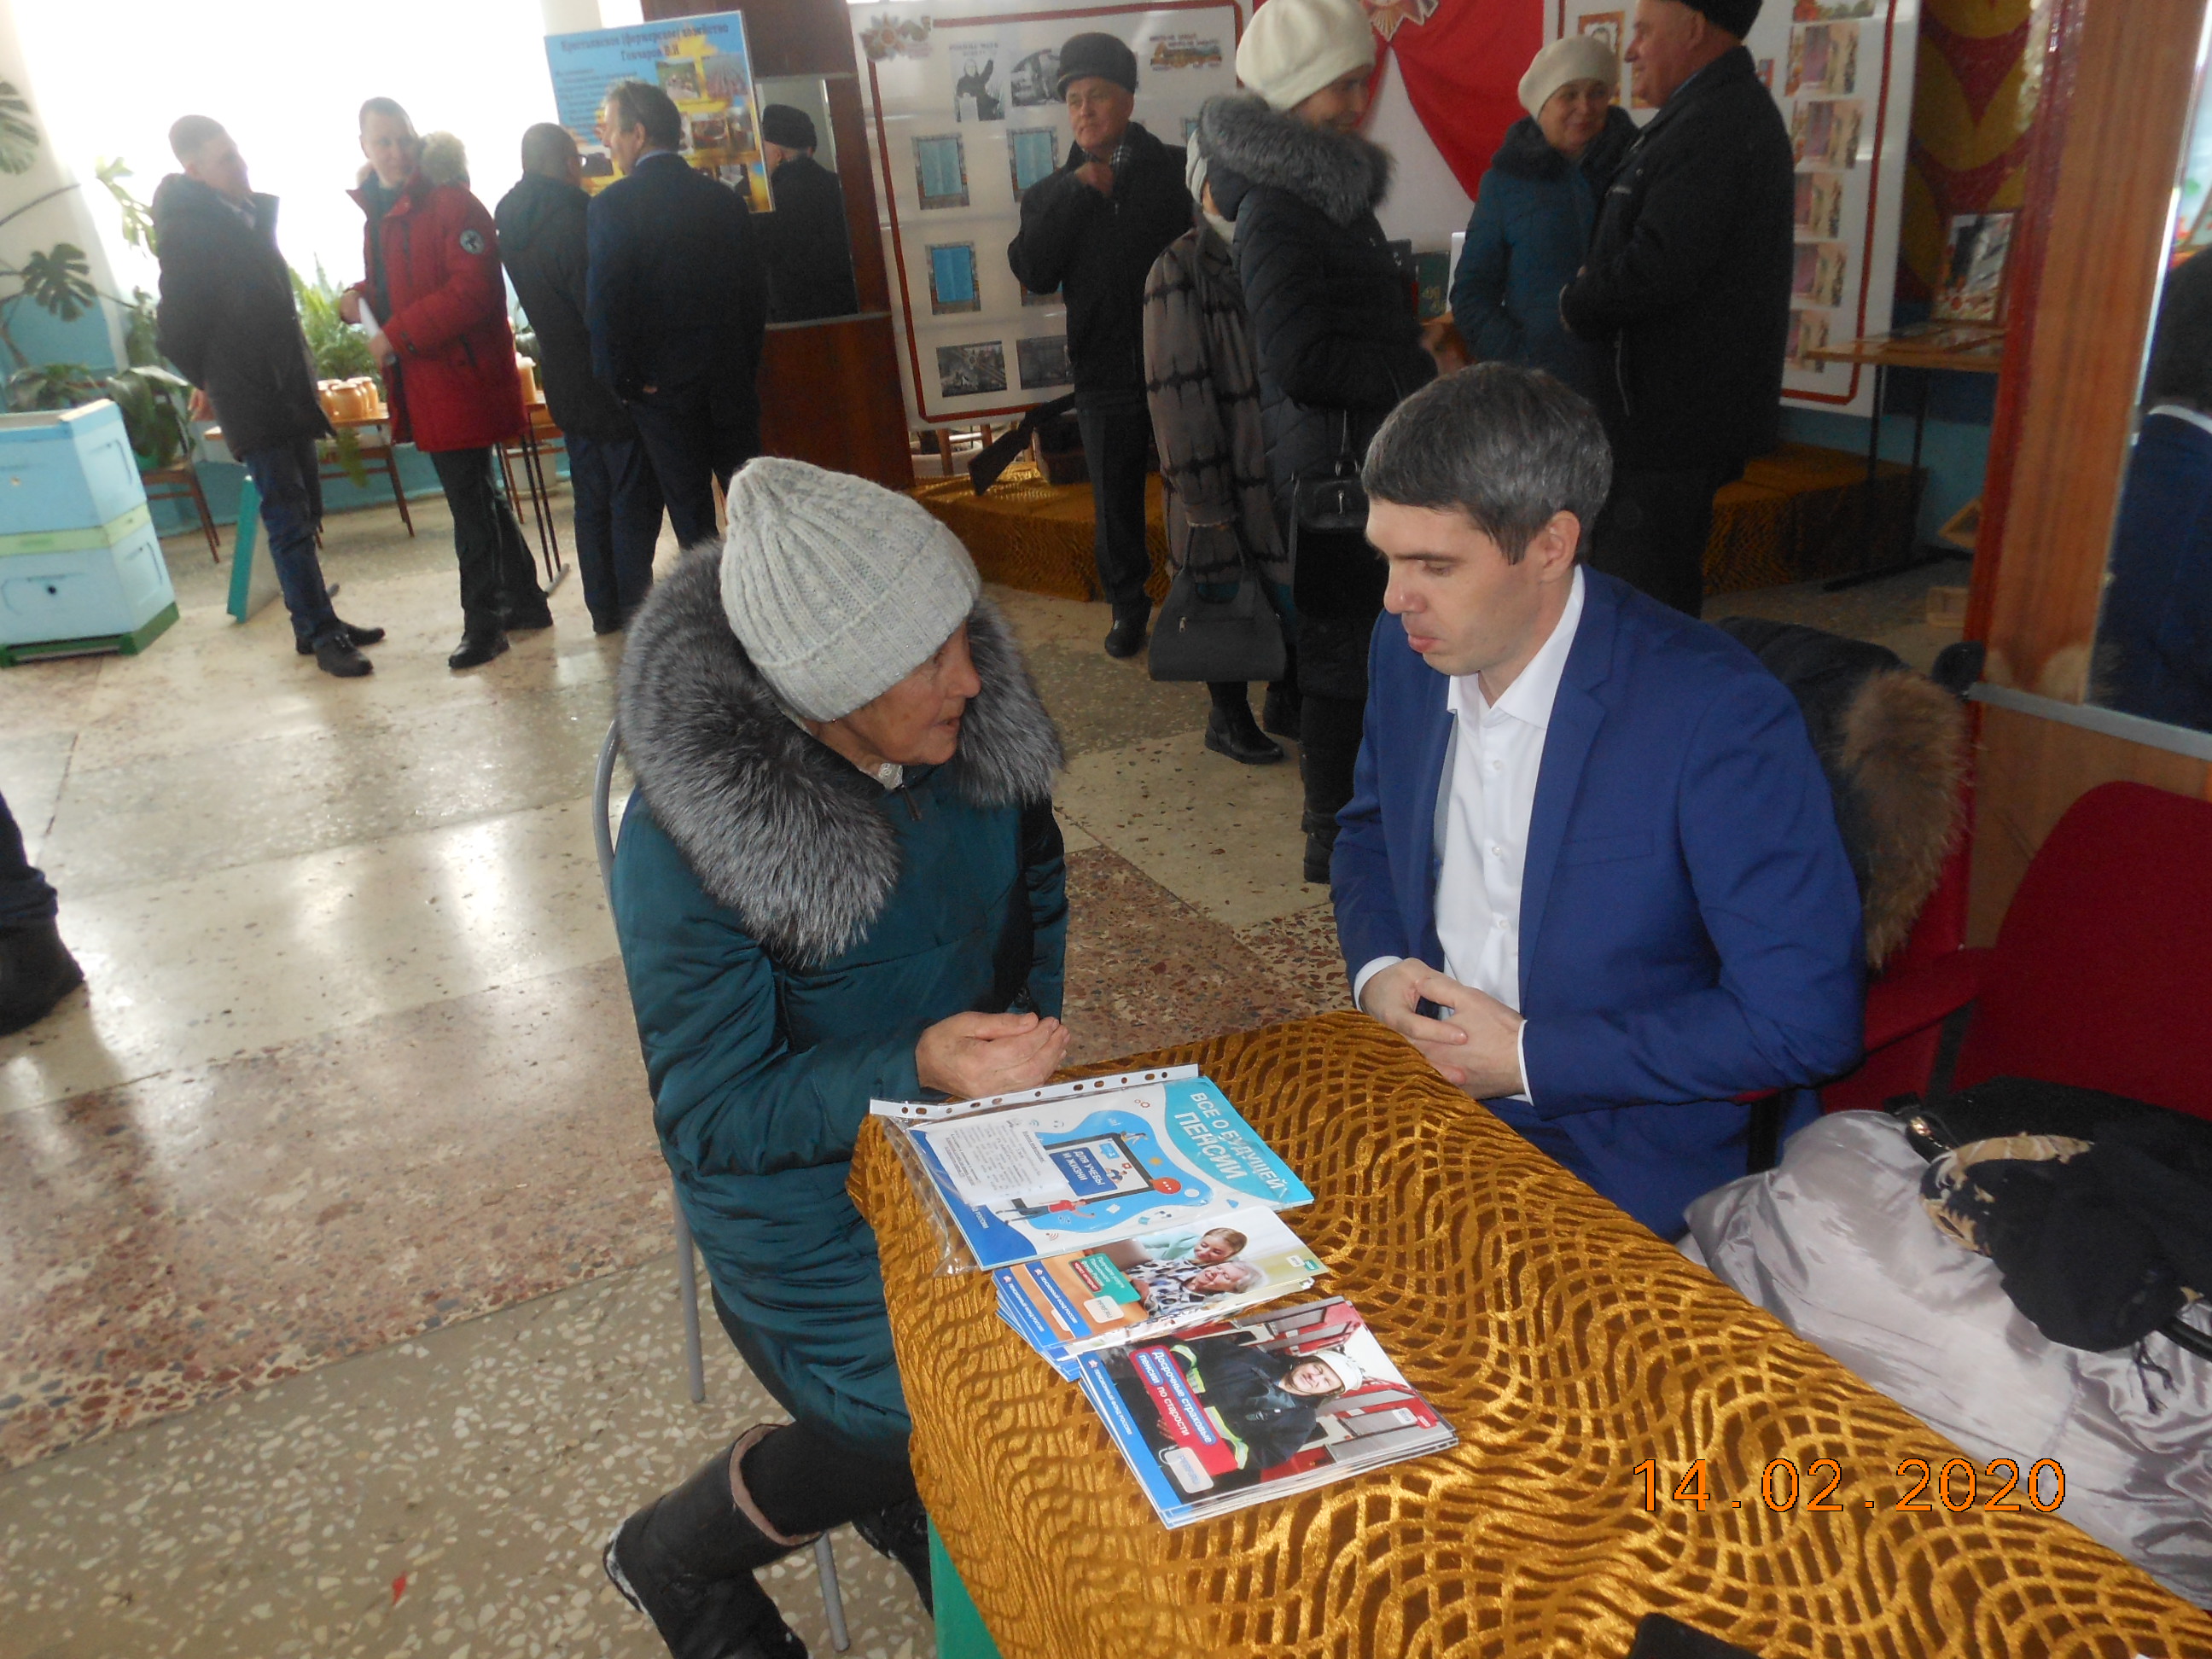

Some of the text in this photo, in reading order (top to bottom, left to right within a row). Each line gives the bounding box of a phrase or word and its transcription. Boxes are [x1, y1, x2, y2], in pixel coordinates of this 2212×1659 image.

[1067, 1158, 1088, 1182] ЖИЗНИ
[1073, 1151, 1106, 1185] ДЛЯ УЧЕБЫ
[1174, 1112, 1247, 1179] ПЕНСИИ
[1190, 1092, 1288, 1190] ВСЕ О БУДУЩЕЙ
[1093, 1369, 1132, 1435] ПЕНСИОННЫЙ ФОНД РОССИИ
[1138, 1354, 1190, 1436] пенсии по старости
[1152, 1351, 1213, 1443] Досрочные страховые
